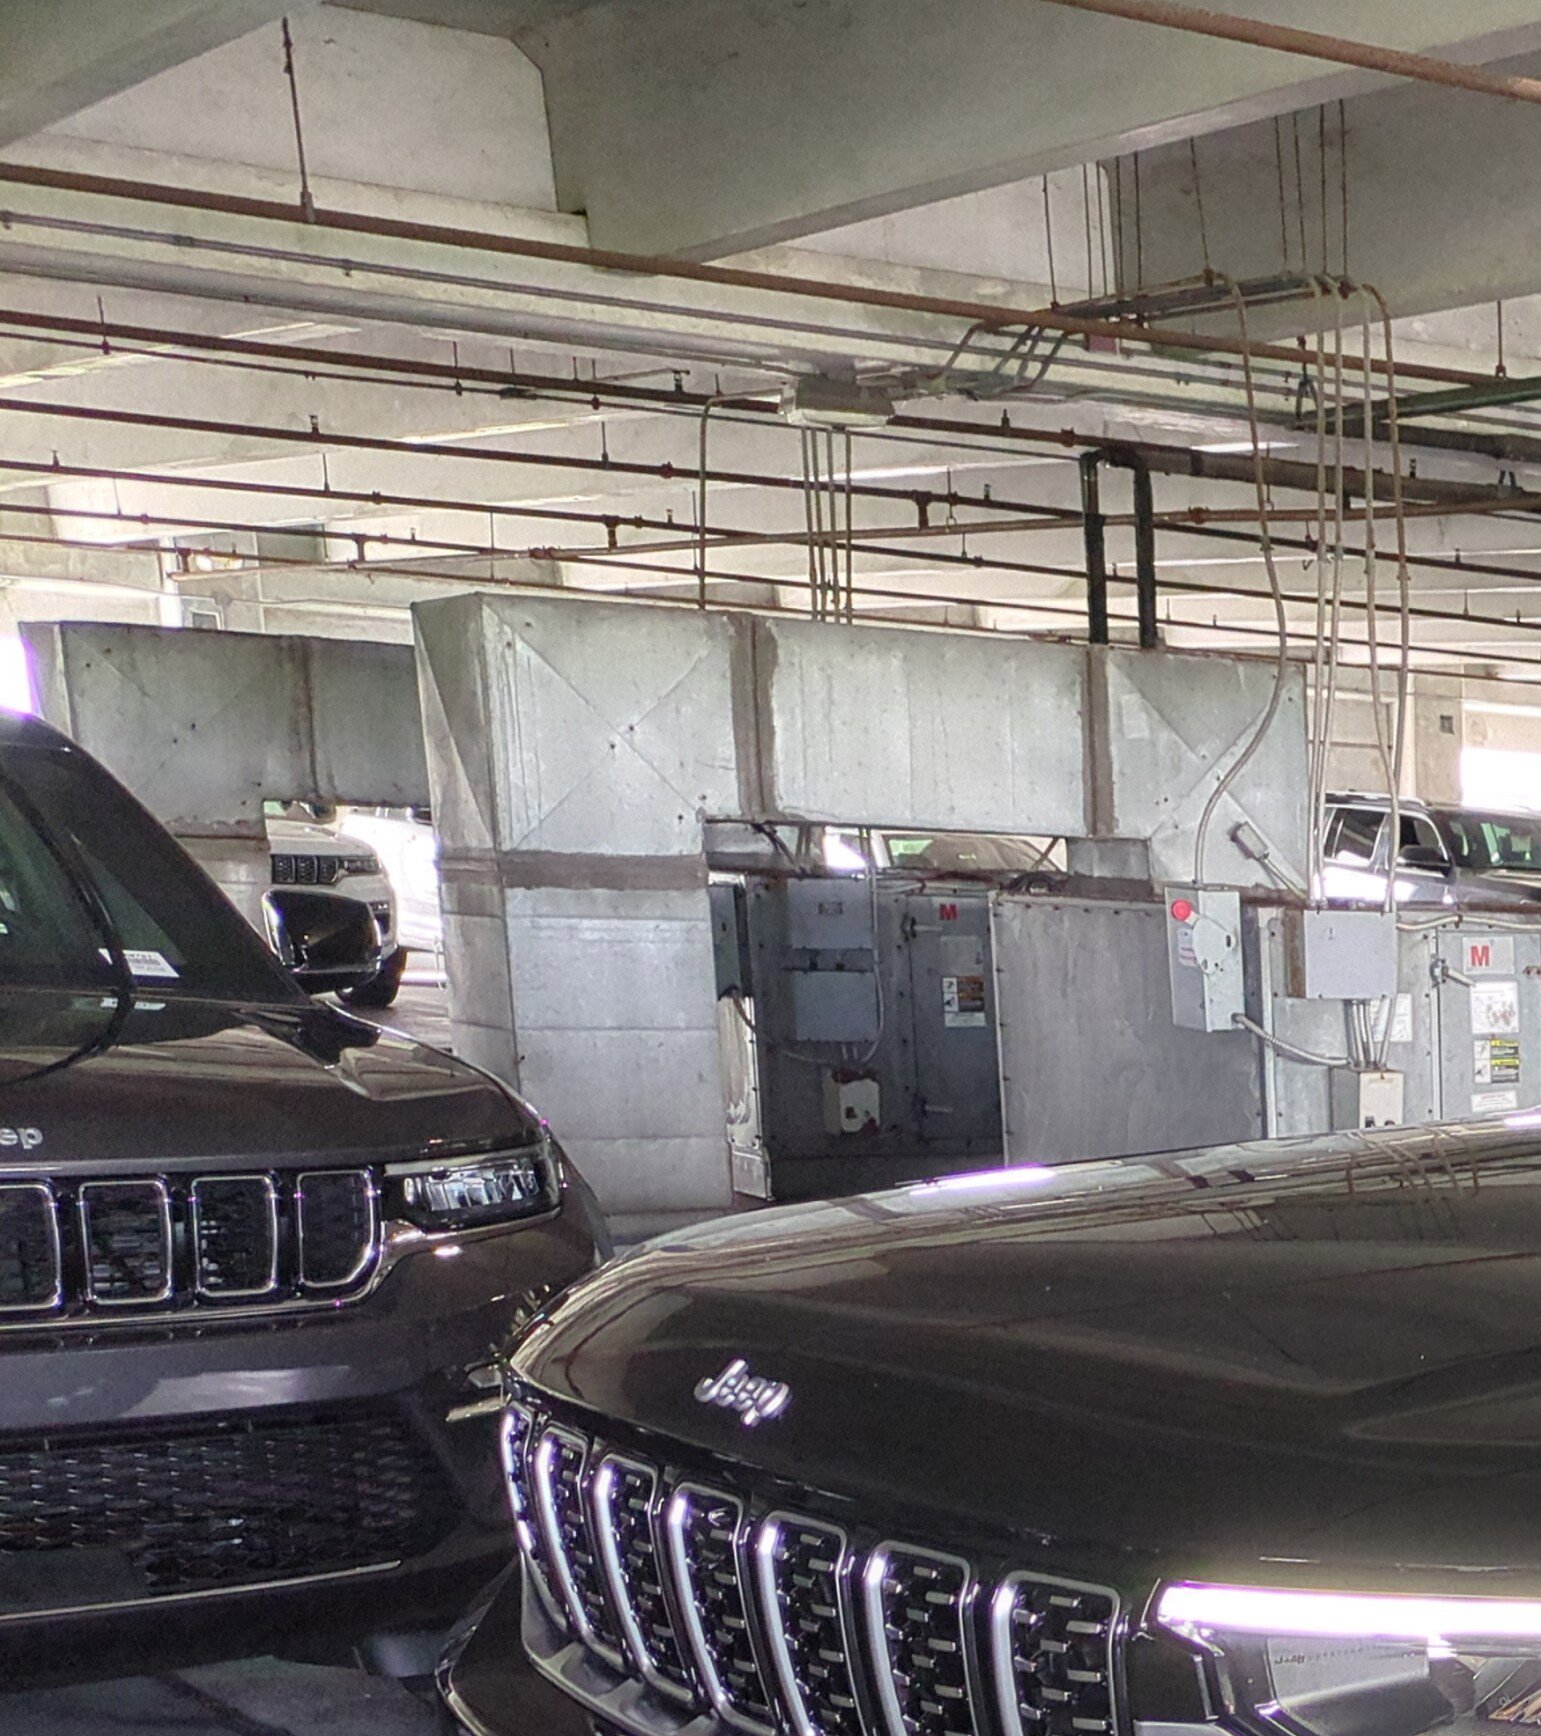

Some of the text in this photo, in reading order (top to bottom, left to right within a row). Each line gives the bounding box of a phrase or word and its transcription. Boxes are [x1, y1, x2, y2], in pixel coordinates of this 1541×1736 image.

[939, 904, 957, 920] M
[1471, 945, 1490, 967] M
[694, 1358, 791, 1427] Jeep
